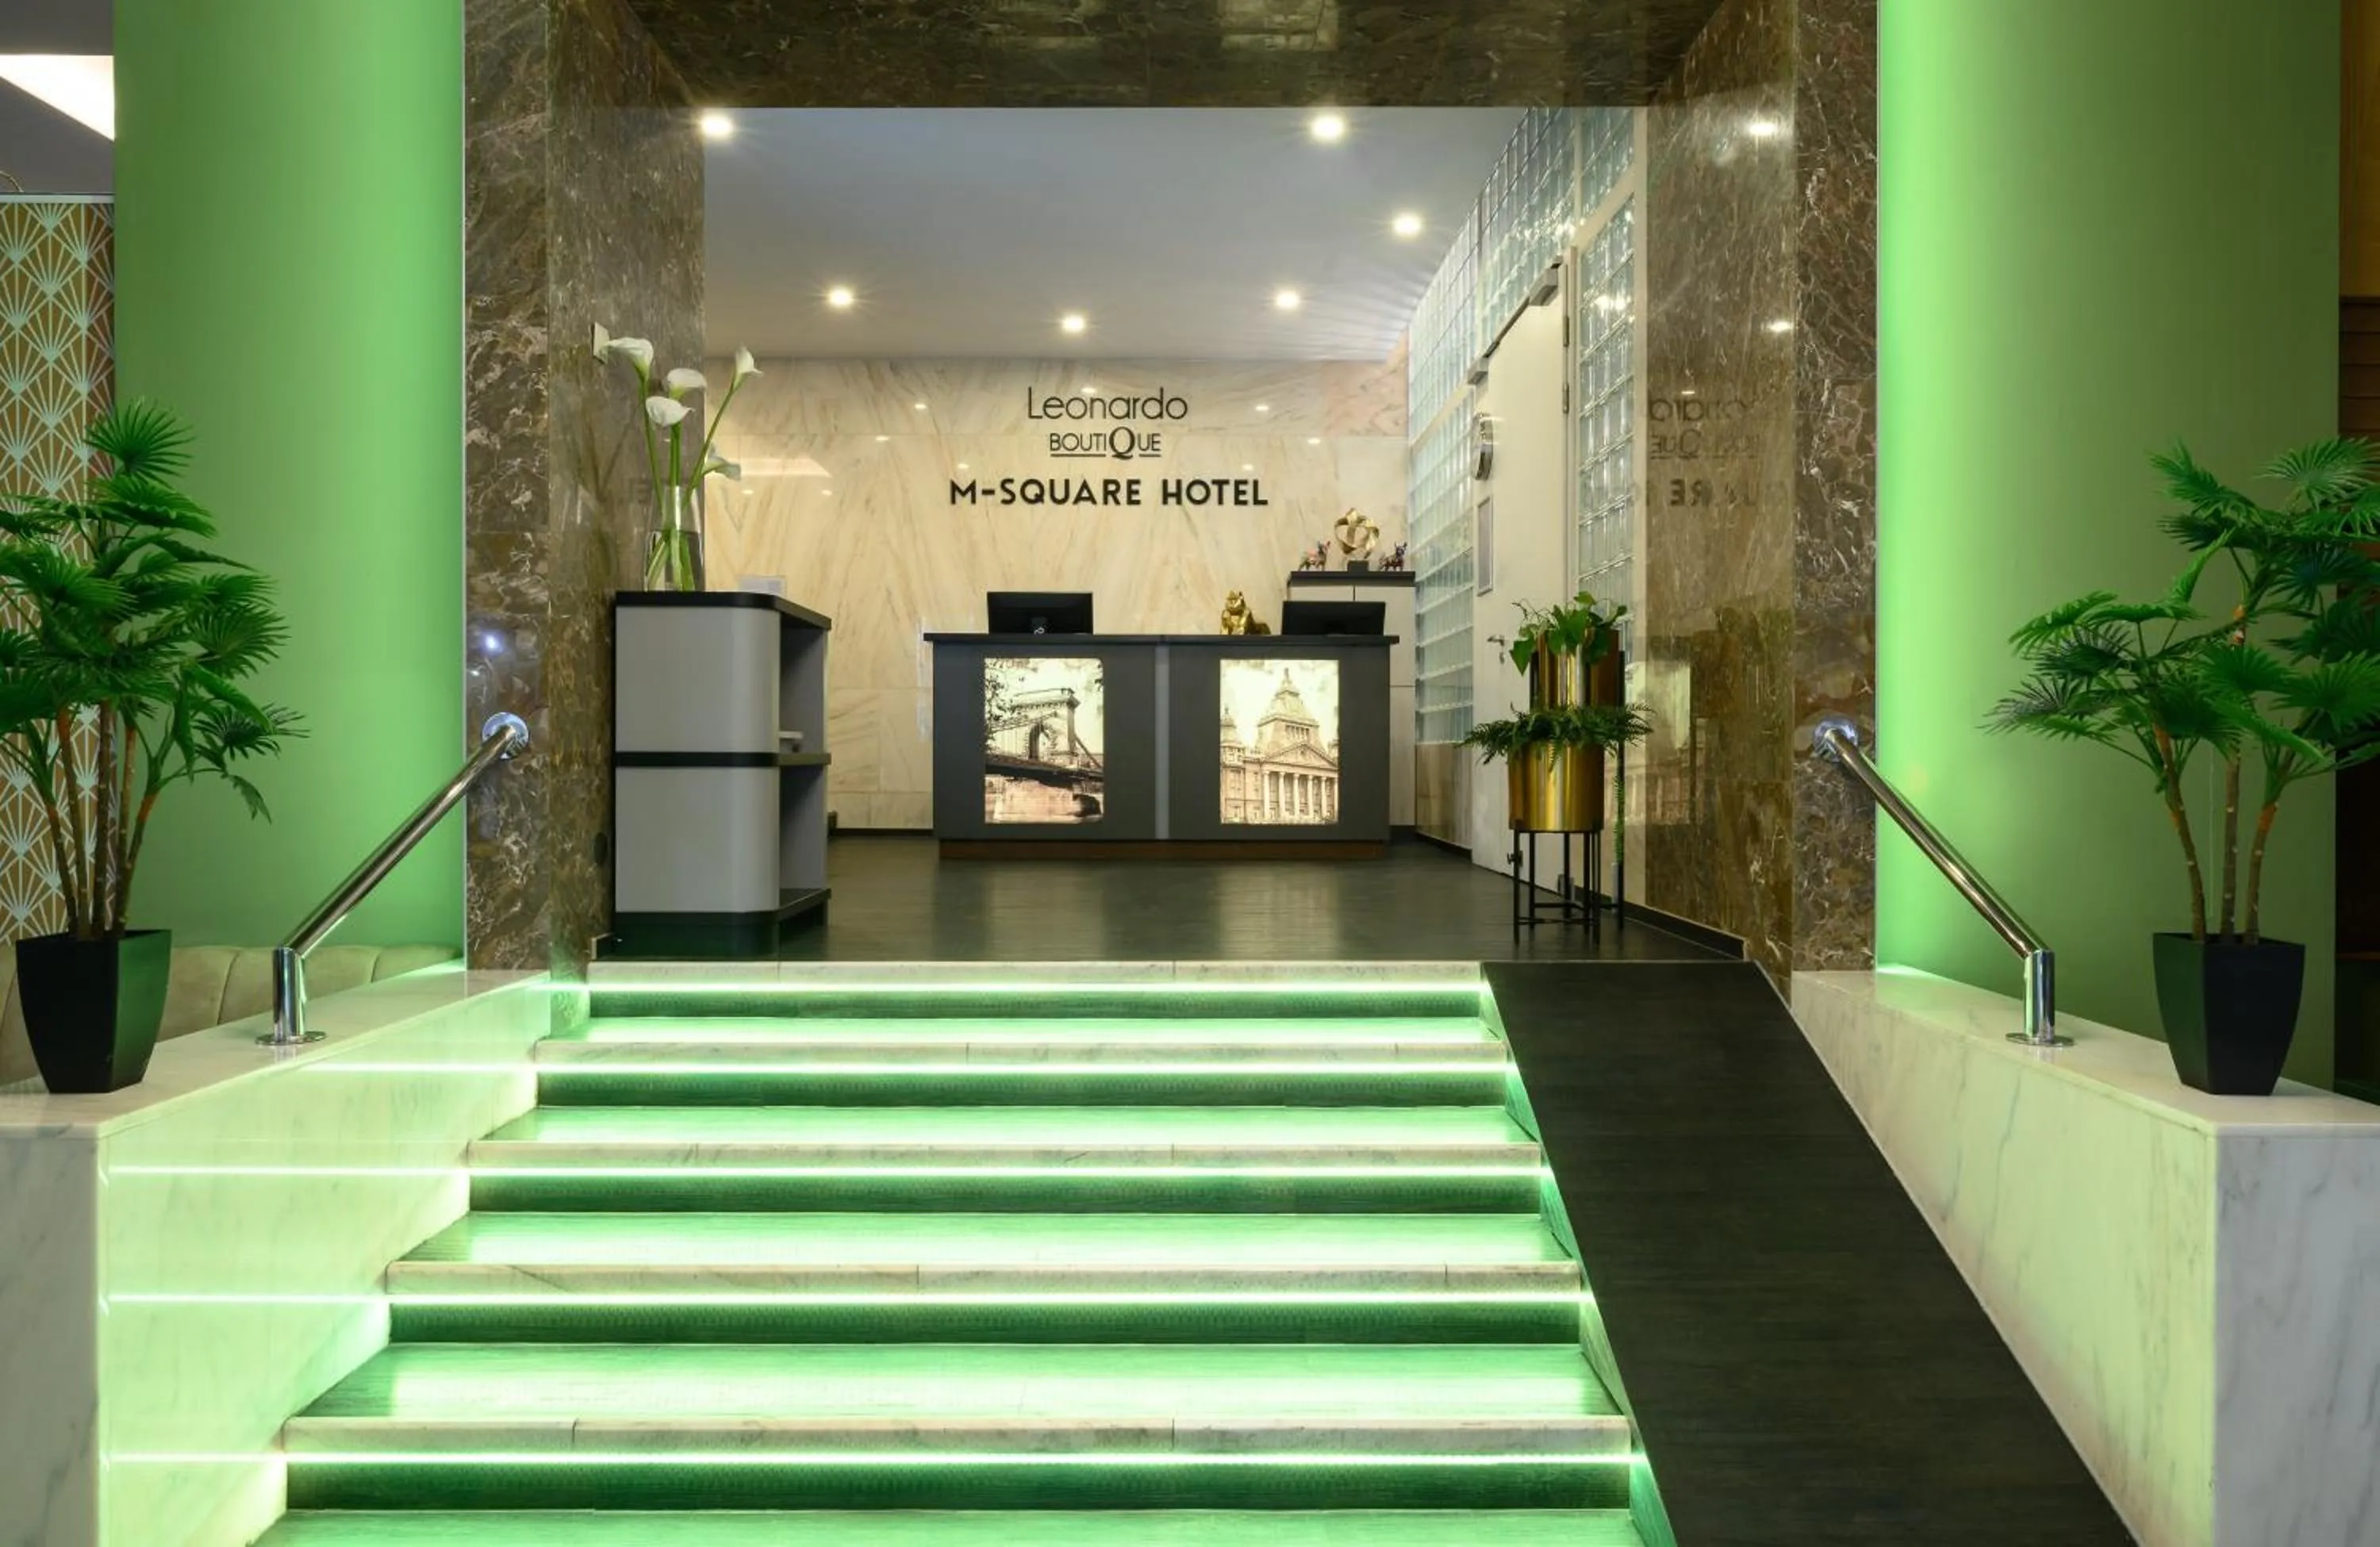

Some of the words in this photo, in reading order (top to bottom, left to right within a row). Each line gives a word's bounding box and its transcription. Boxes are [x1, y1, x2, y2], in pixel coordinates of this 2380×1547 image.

[1027, 386, 1188, 420] Leonardo
[1049, 426, 1162, 460] BOUTIQUE
[950, 478, 1142, 506] M-SQUARE
[1161, 478, 1269, 506] HOTEL
